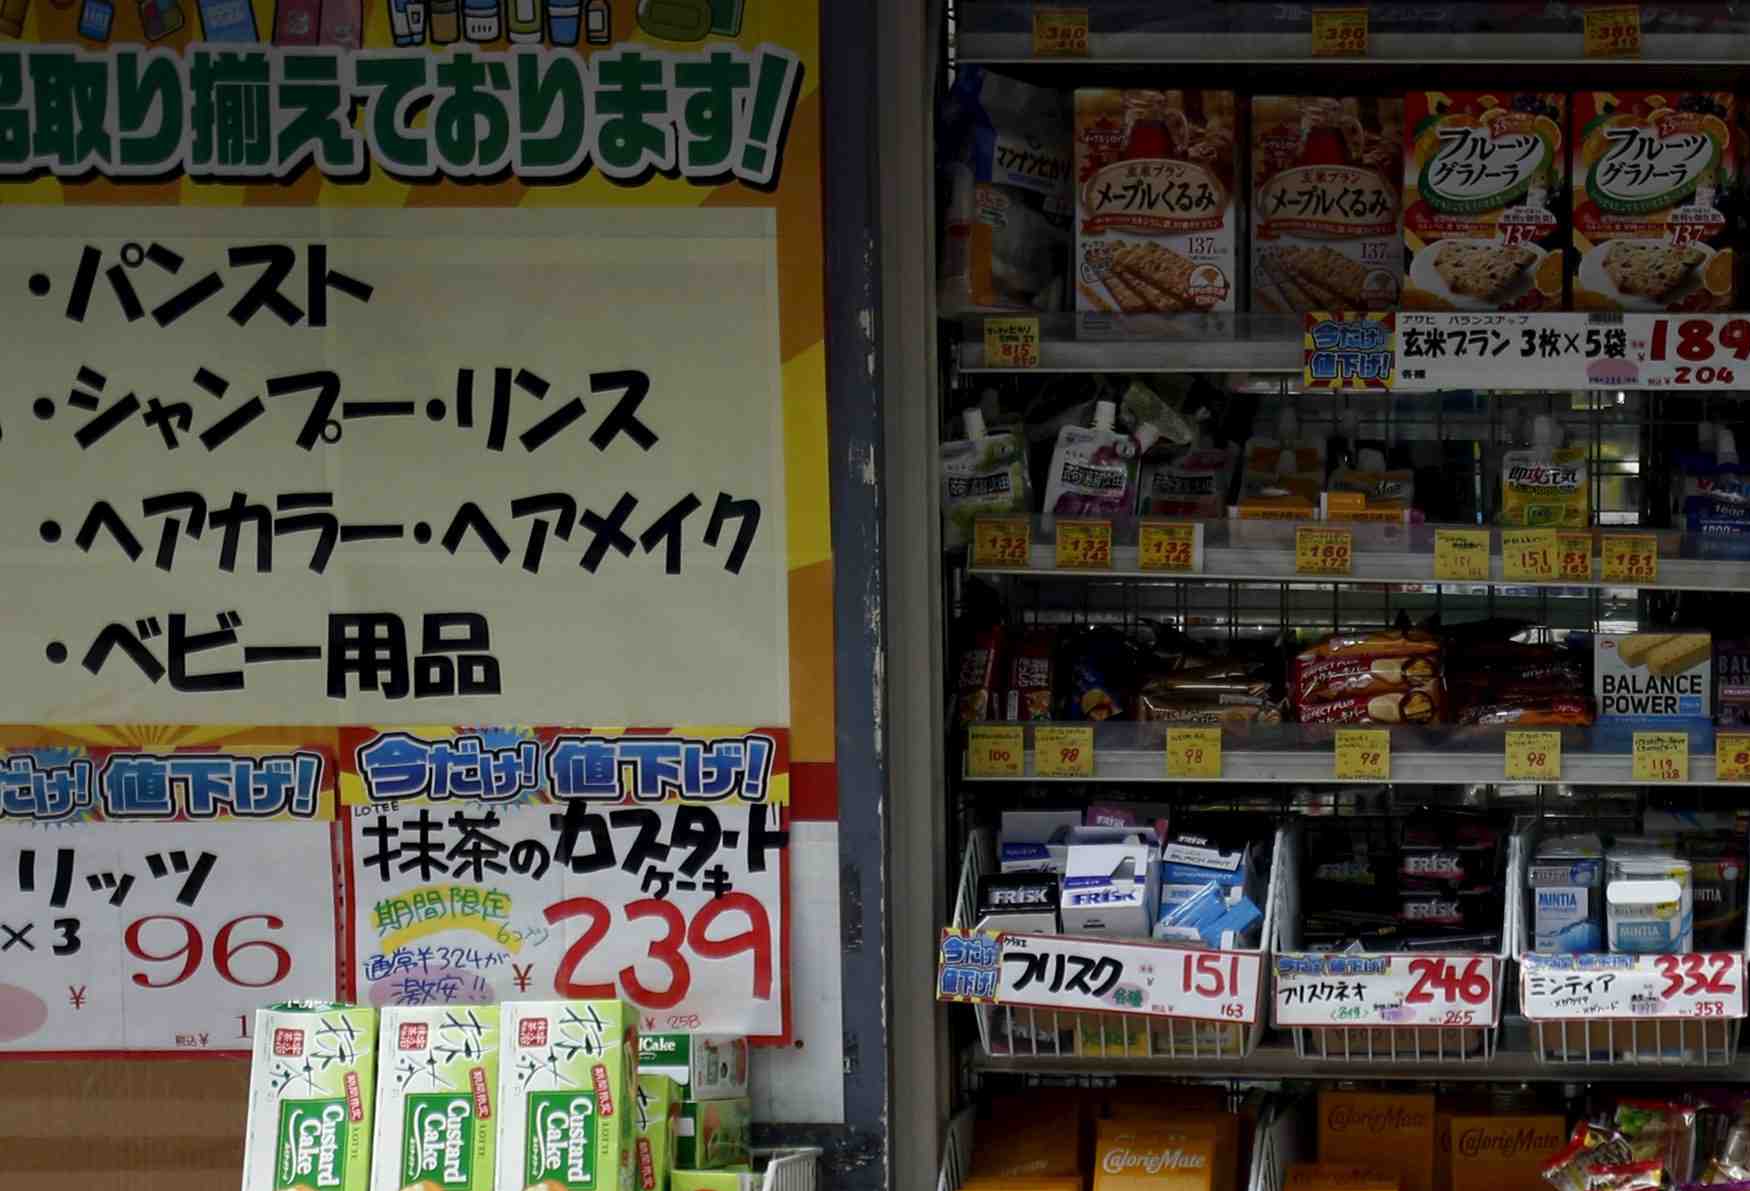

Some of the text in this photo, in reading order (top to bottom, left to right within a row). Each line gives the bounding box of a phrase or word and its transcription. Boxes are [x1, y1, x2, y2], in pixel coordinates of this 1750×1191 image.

[1439, 129, 1540, 160] フルーツ
[1607, 129, 1707, 160] フルーツ
[1434, 162, 1519, 187] グラノーラ
[1602, 162, 1688, 187] グラノーラ
[1096, 178, 1216, 212] メープルくるみ
[1270, 180, 1390, 216] メープルくるみ
[1188, 237, 1215, 254] 137
[1675, 367, 1734, 384] 204
[1152, 541, 1189, 553] 132
[1310, 545, 1347, 557] 160
[1521, 551, 1548, 569] 151
[1603, 675, 1702, 694] BALANCE
[1603, 696, 1677, 714] POWER
[365, 735, 766, 799] 今だけ! 値下げ!
[105, 754, 320, 816] 値下げ!
[362, 801, 788, 881] 抹茶のカスタード
[18, 849, 218, 907] リッツ
[1406, 855, 1463, 874] FRISK
[641, 865, 733, 899] ケーキ
[992, 887, 1048, 904] FRISK
[1073, 888, 1136, 906] FRISK
[374, 889, 511, 936] 期間限定
[1406, 901, 1462, 921] FRISK
[124, 914, 292, 988] 96
[544, 892, 771, 1010] 239
[1003, 953, 1123, 997] フリスク
[1184, 954, 1240, 998] 151
[1406, 958, 1491, 1005] 246
[1530, 974, 1616, 996] ミンティア
[1654, 953, 1737, 1000] 332
[1279, 980, 1368, 1005] フリスクネオ
[667, 1014, 700, 1029] 258
[1220, 1003, 1244, 1018] 163
[1443, 1010, 1473, 1025] 265
[1694, 1002, 1724, 1017] 358
[1328, 1104, 1424, 1131] CalorieMate
[296, 1118, 322, 1175] Cake
[317, 1104, 345, 1186] Custard
[422, 1113, 446, 1171] Cake
[443, 1100, 470, 1184] Custard
[546, 1111, 569, 1170] Cake
[568, 1097, 592, 1182] Custard
[1459, 1126, 1560, 1155] CalorieMate
[1103, 1148, 1206, 1174] CalorieMate
